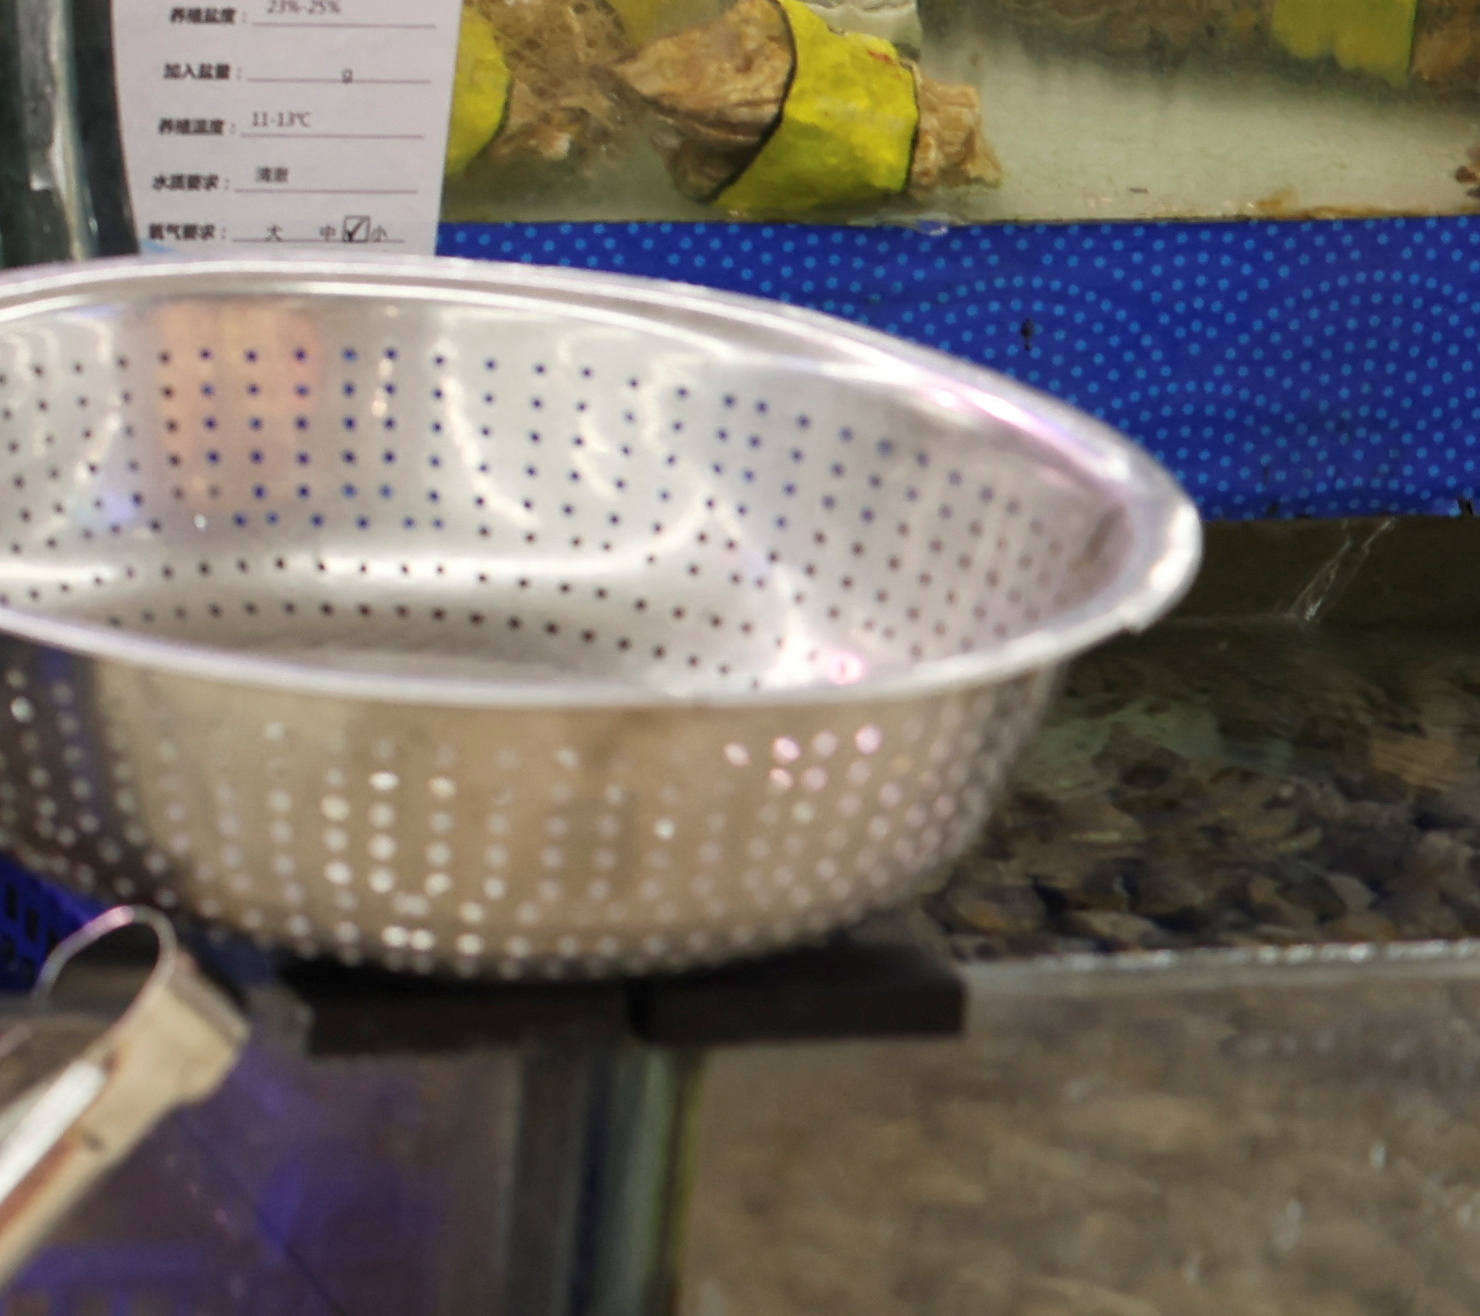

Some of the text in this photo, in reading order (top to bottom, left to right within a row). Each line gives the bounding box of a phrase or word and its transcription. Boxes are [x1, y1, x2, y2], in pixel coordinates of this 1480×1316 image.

[265, 223, 284, 243] 大
[318, 224, 337, 243] 中
[370, 224, 388, 243] 小
